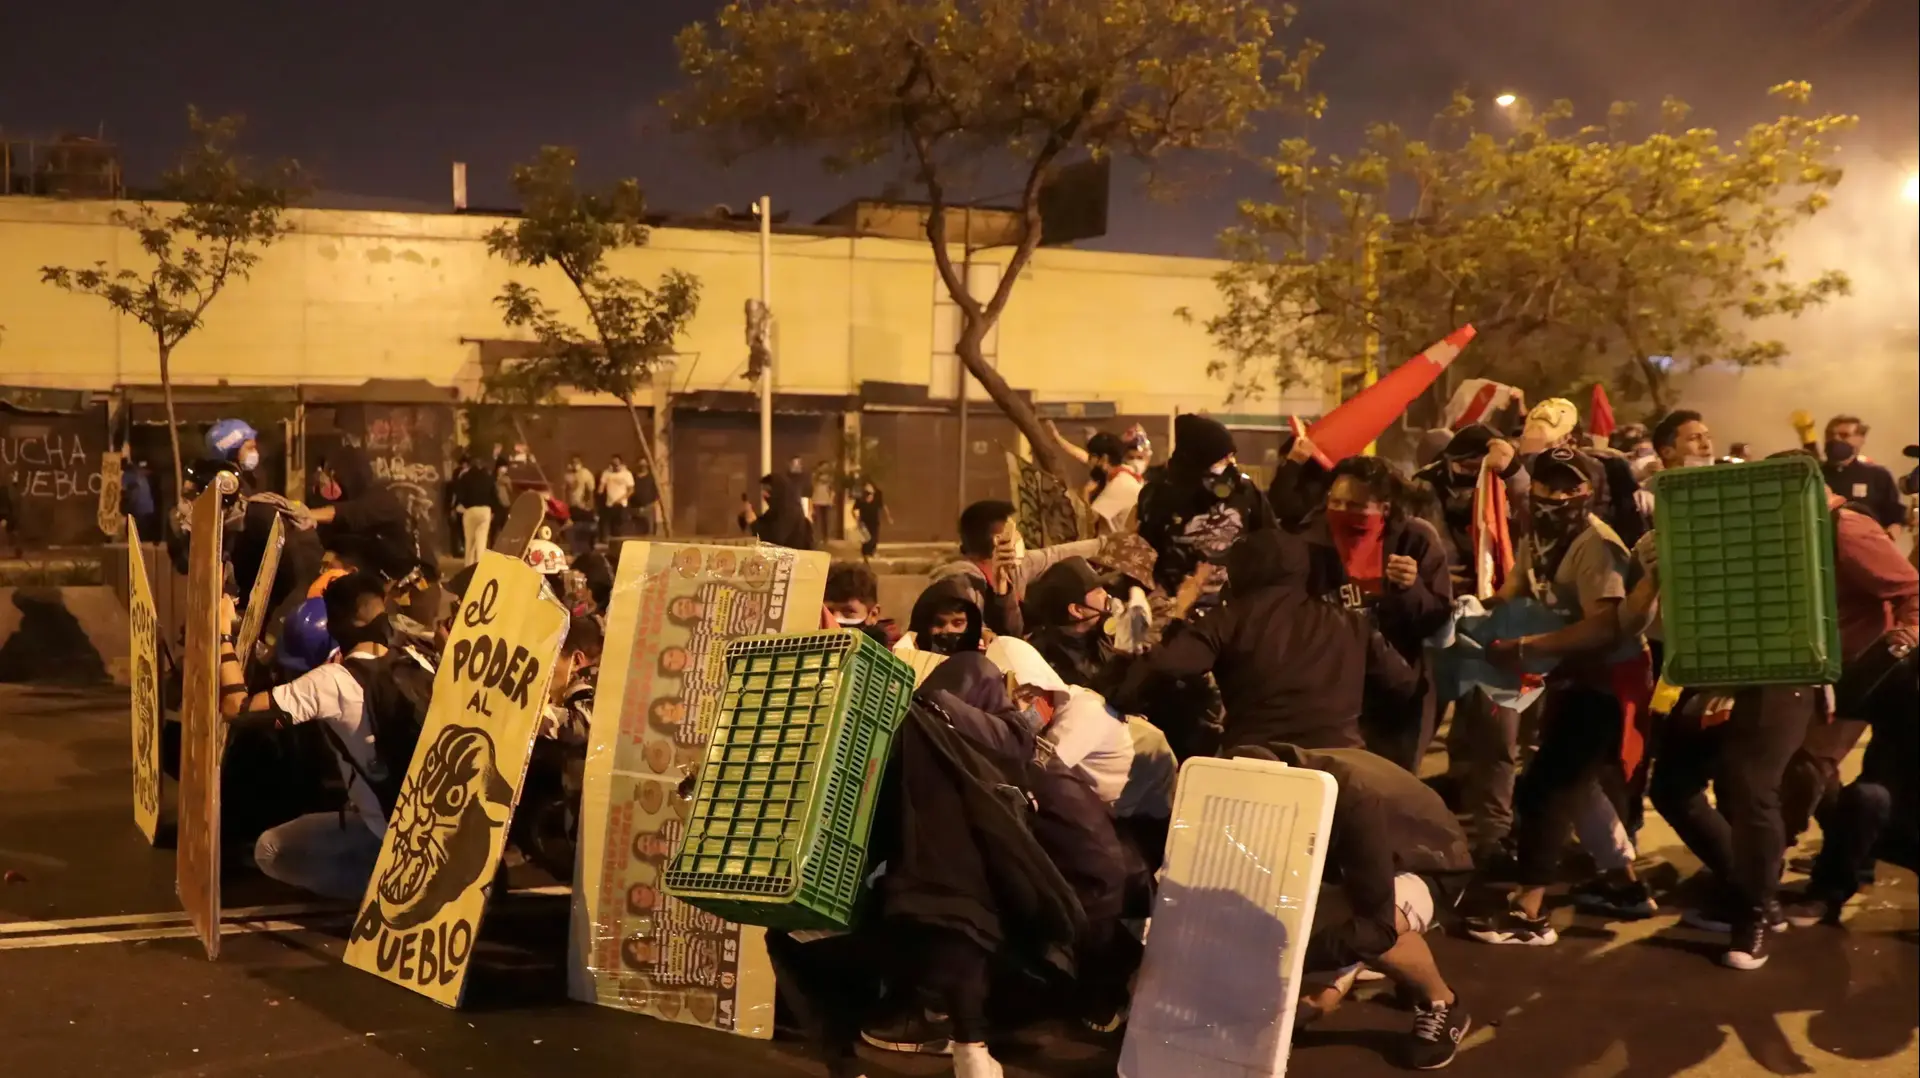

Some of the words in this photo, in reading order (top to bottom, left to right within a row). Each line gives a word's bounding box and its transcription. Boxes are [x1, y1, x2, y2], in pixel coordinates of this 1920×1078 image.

[464, 578, 499, 628] el
[768, 557, 793, 620] GENTE
[453, 634, 540, 710] PODER
[466, 689, 493, 717] AL
[350, 899, 471, 986] PUEBLO
[723, 939, 737, 962] ES
[719, 999, 733, 1026] LA
